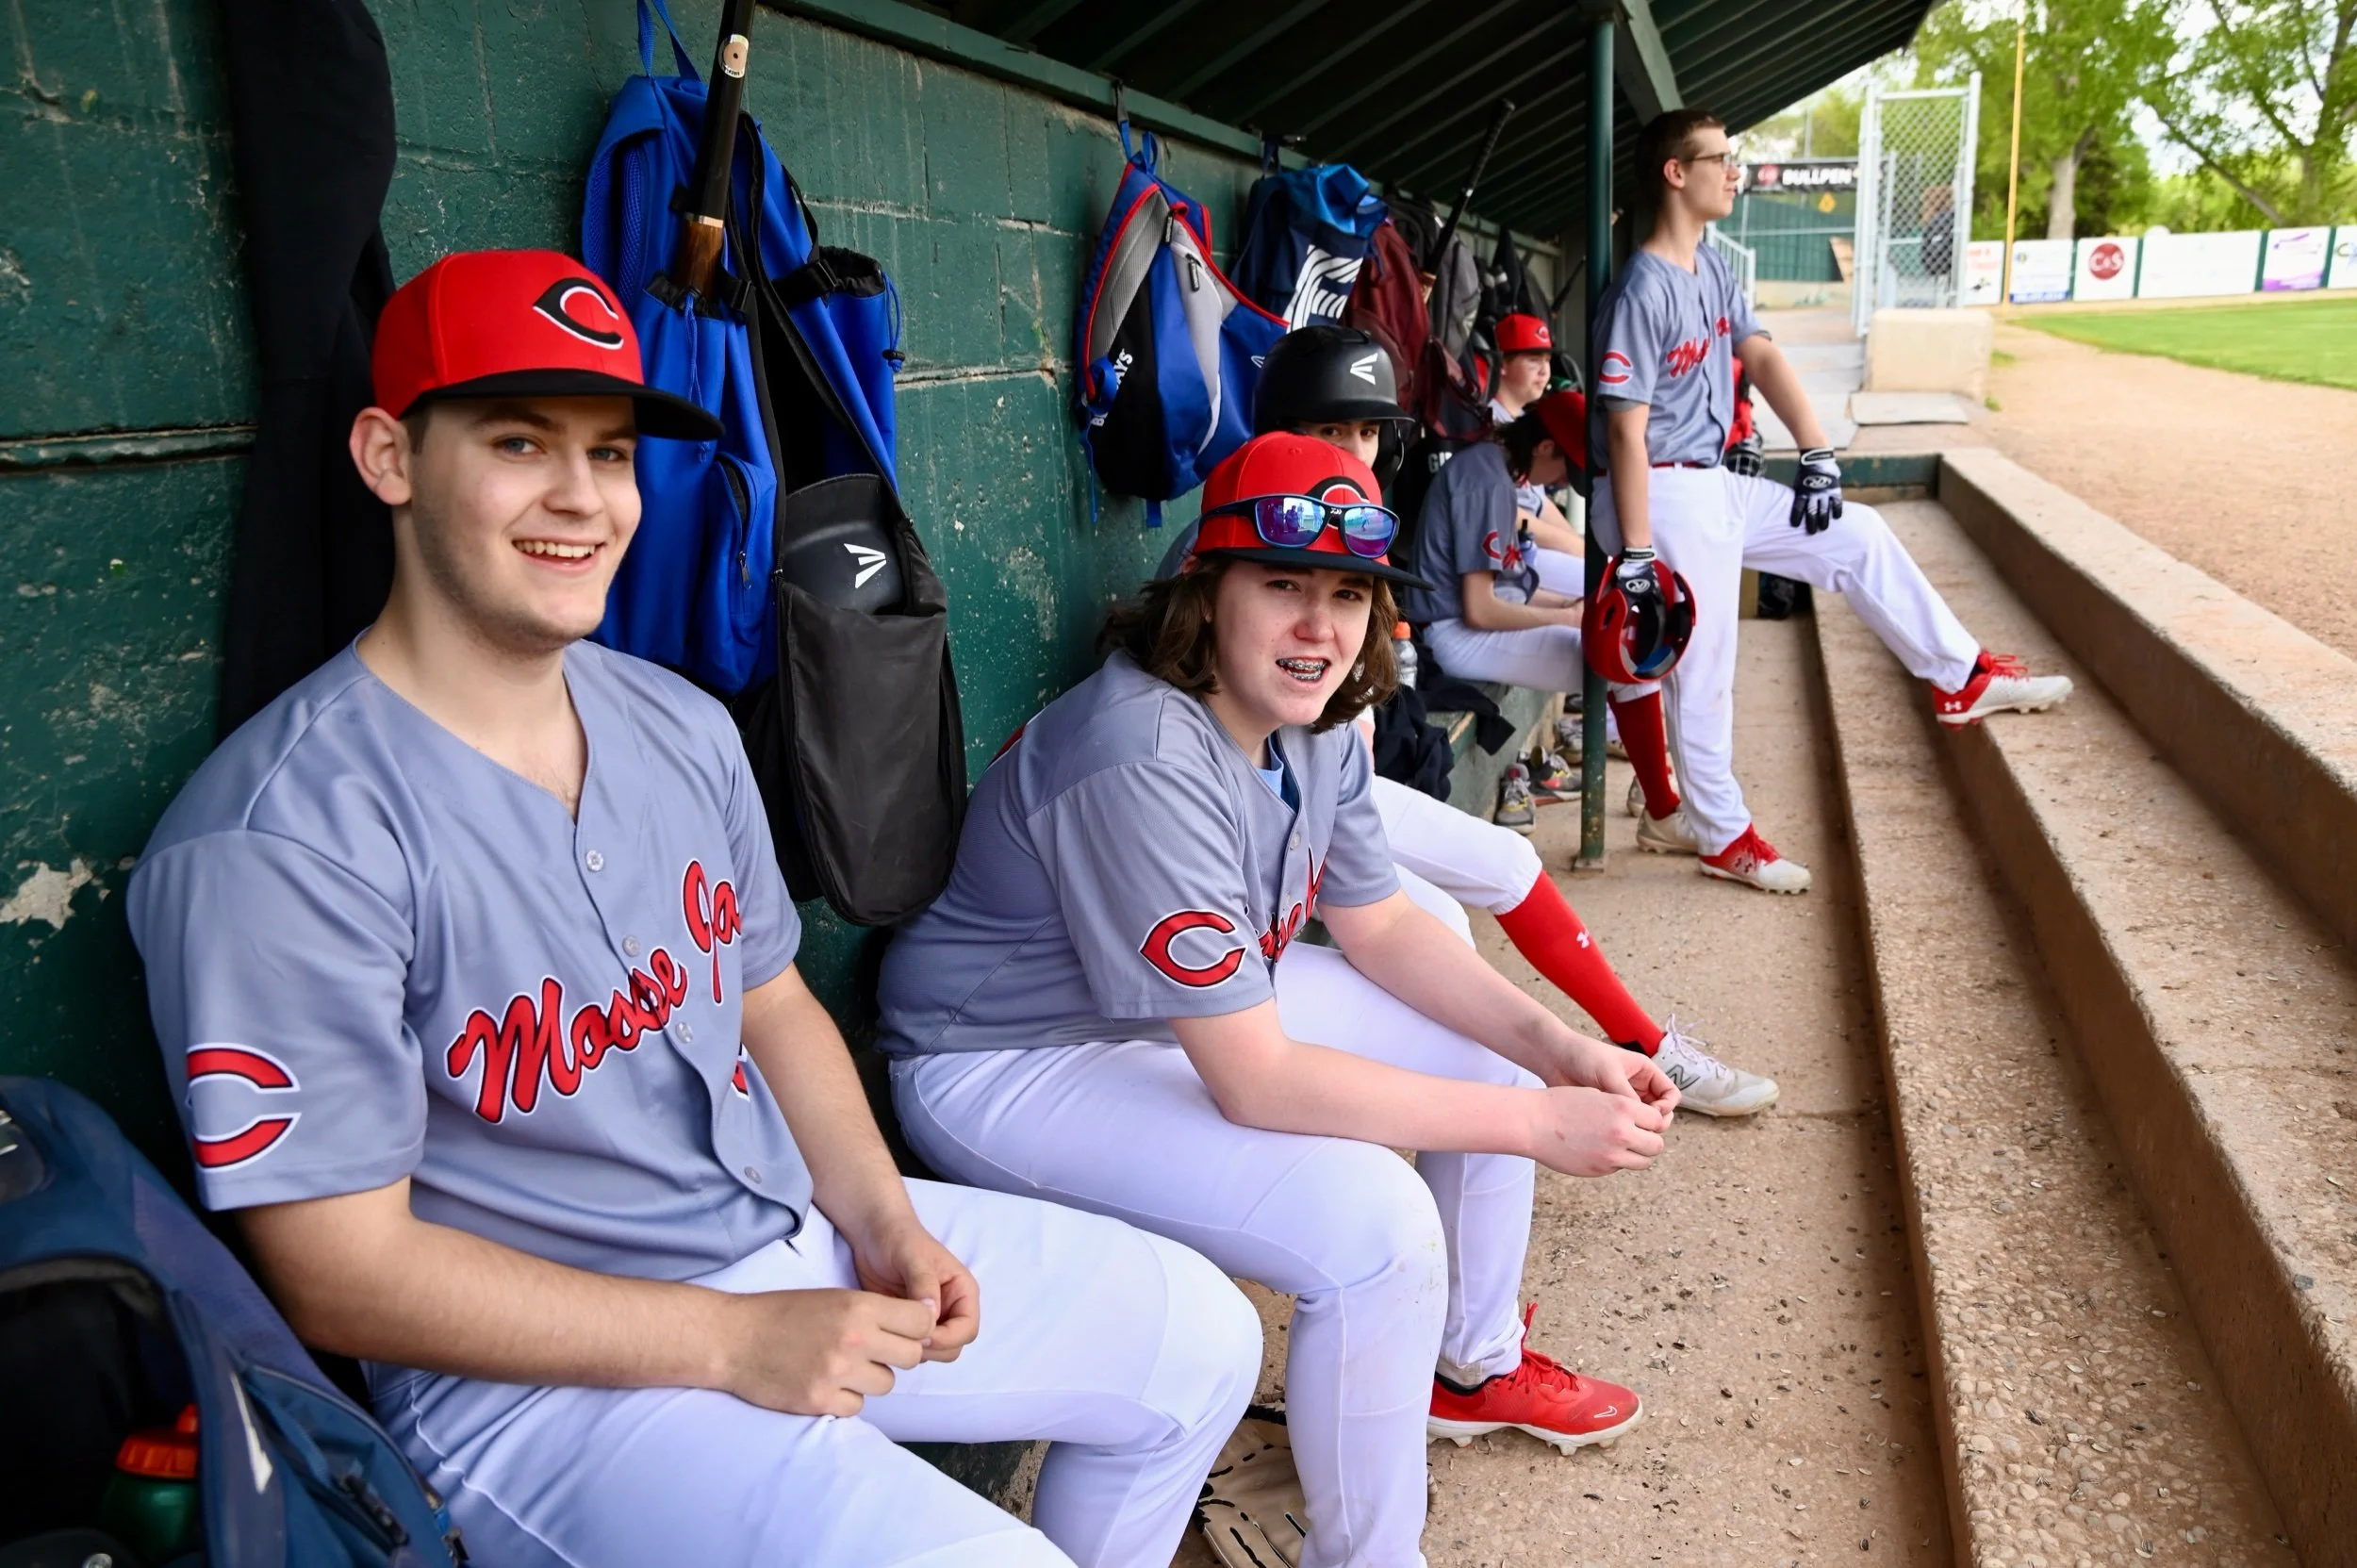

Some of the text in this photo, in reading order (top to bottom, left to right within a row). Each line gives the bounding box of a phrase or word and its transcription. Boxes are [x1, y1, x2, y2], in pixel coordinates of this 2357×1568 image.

[1782, 168, 1853, 186] BULLPEN
[533, 276, 624, 351] C
[1599, 349, 1634, 386] C
[1138, 908, 1249, 990] C
[445, 947, 689, 1127] Moose
[185, 1042, 303, 1175] C
